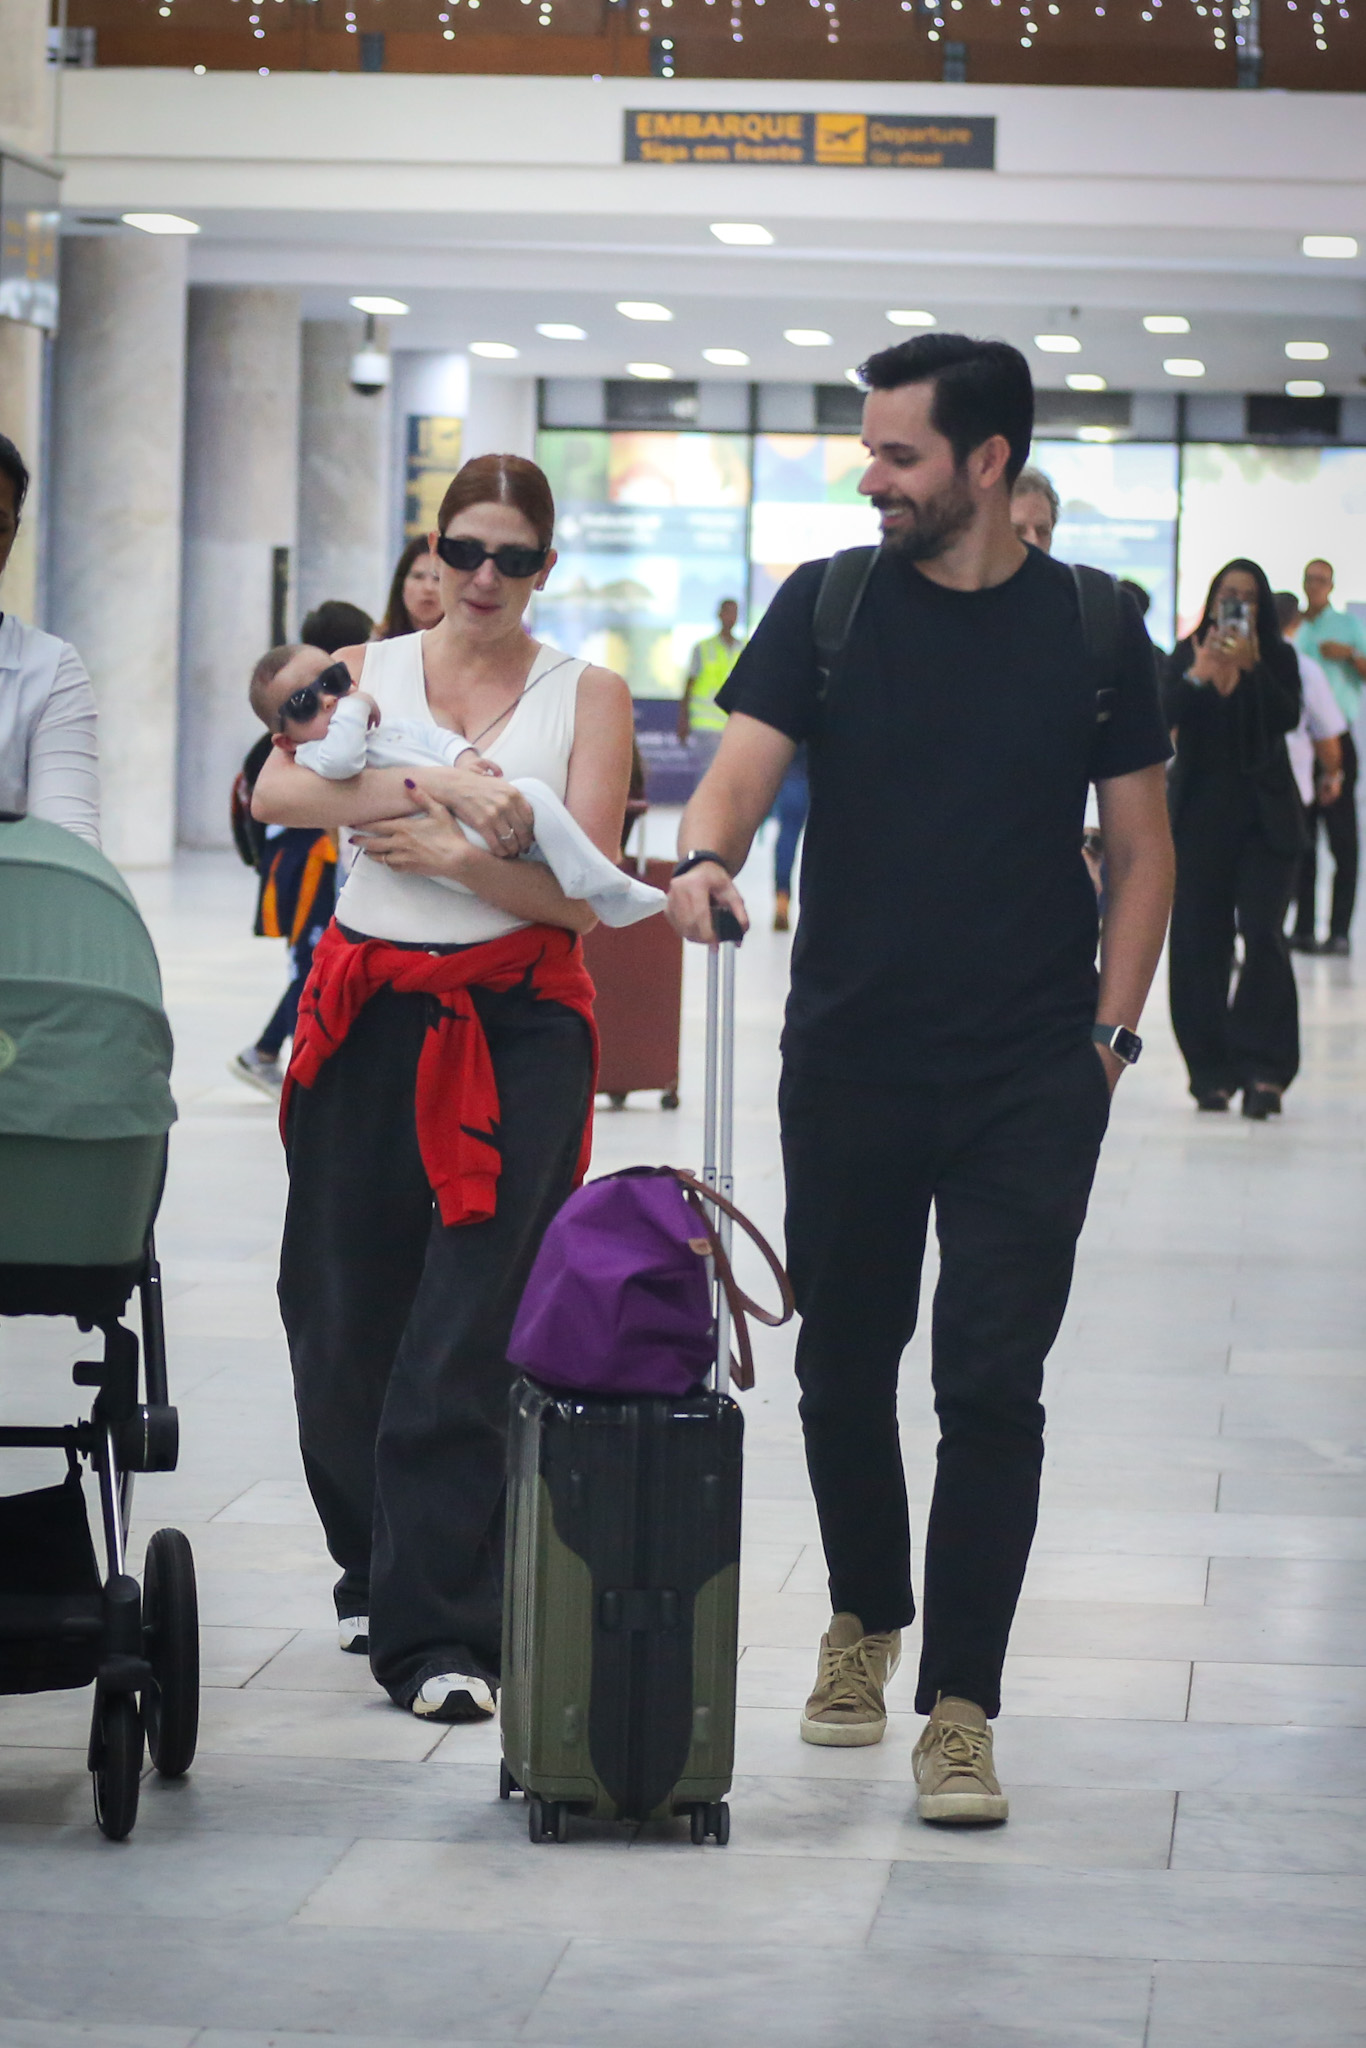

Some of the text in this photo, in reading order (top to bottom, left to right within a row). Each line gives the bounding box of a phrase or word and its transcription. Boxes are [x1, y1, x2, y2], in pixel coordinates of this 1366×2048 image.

[636, 113, 803, 141] EMBARQUE
[870, 122, 972, 145] Departure
[641, 141, 803, 163] Siga em frente
